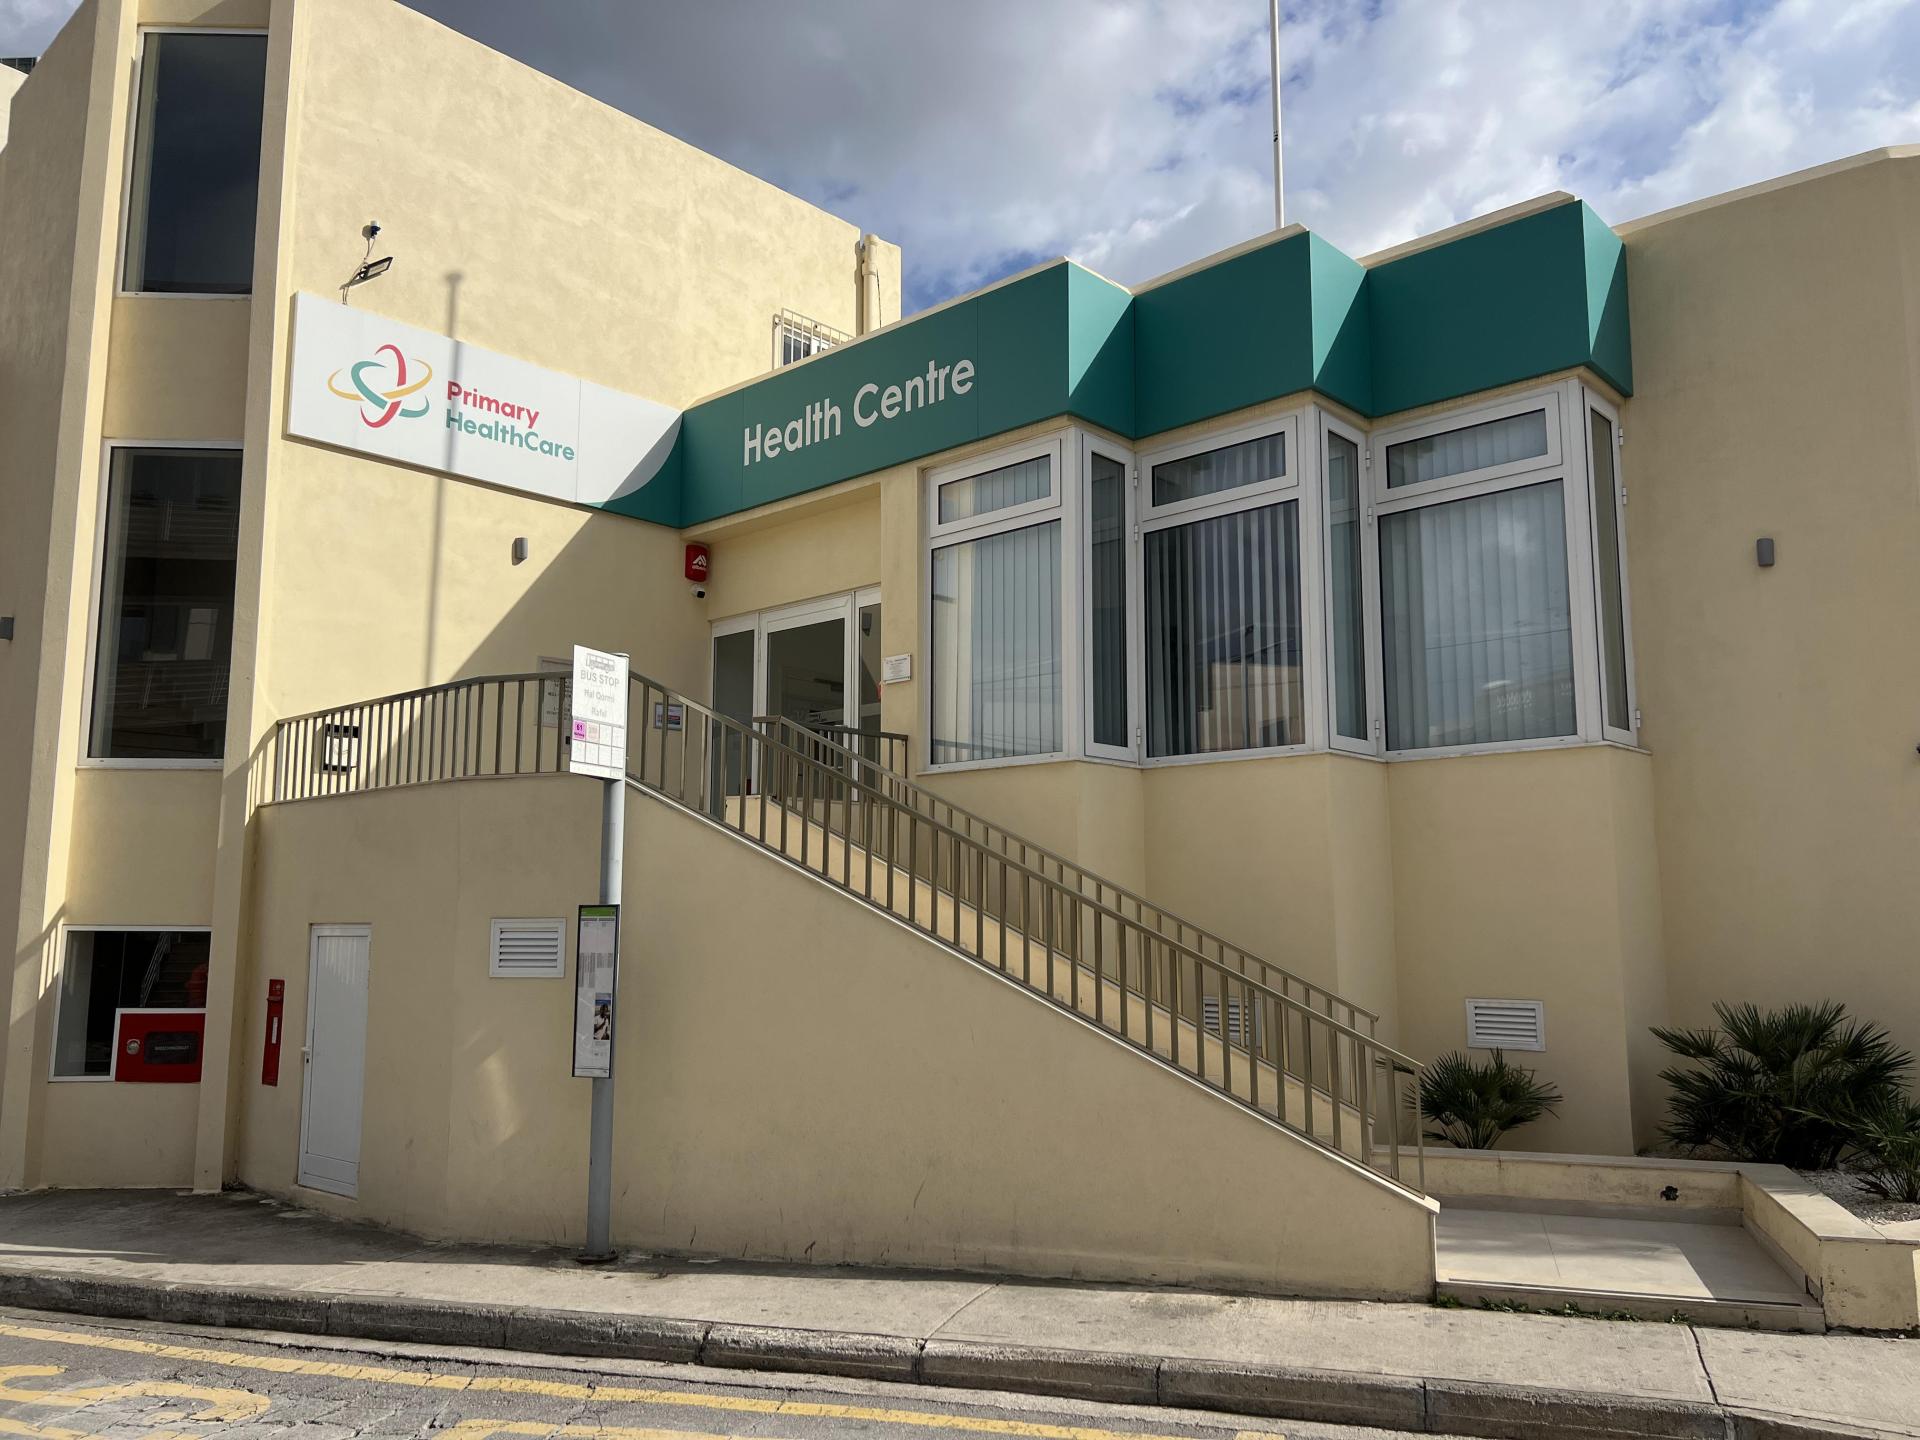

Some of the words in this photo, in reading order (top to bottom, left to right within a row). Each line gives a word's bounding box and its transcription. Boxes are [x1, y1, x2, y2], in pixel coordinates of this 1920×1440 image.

[447, 380, 539, 429] Primary
[744, 398, 841, 466] Health
[853, 359, 975, 428] Centre
[446, 409, 575, 460] HealthCare
[580, 669, 597, 682] BUS
[599, 674, 620, 687] STOP
